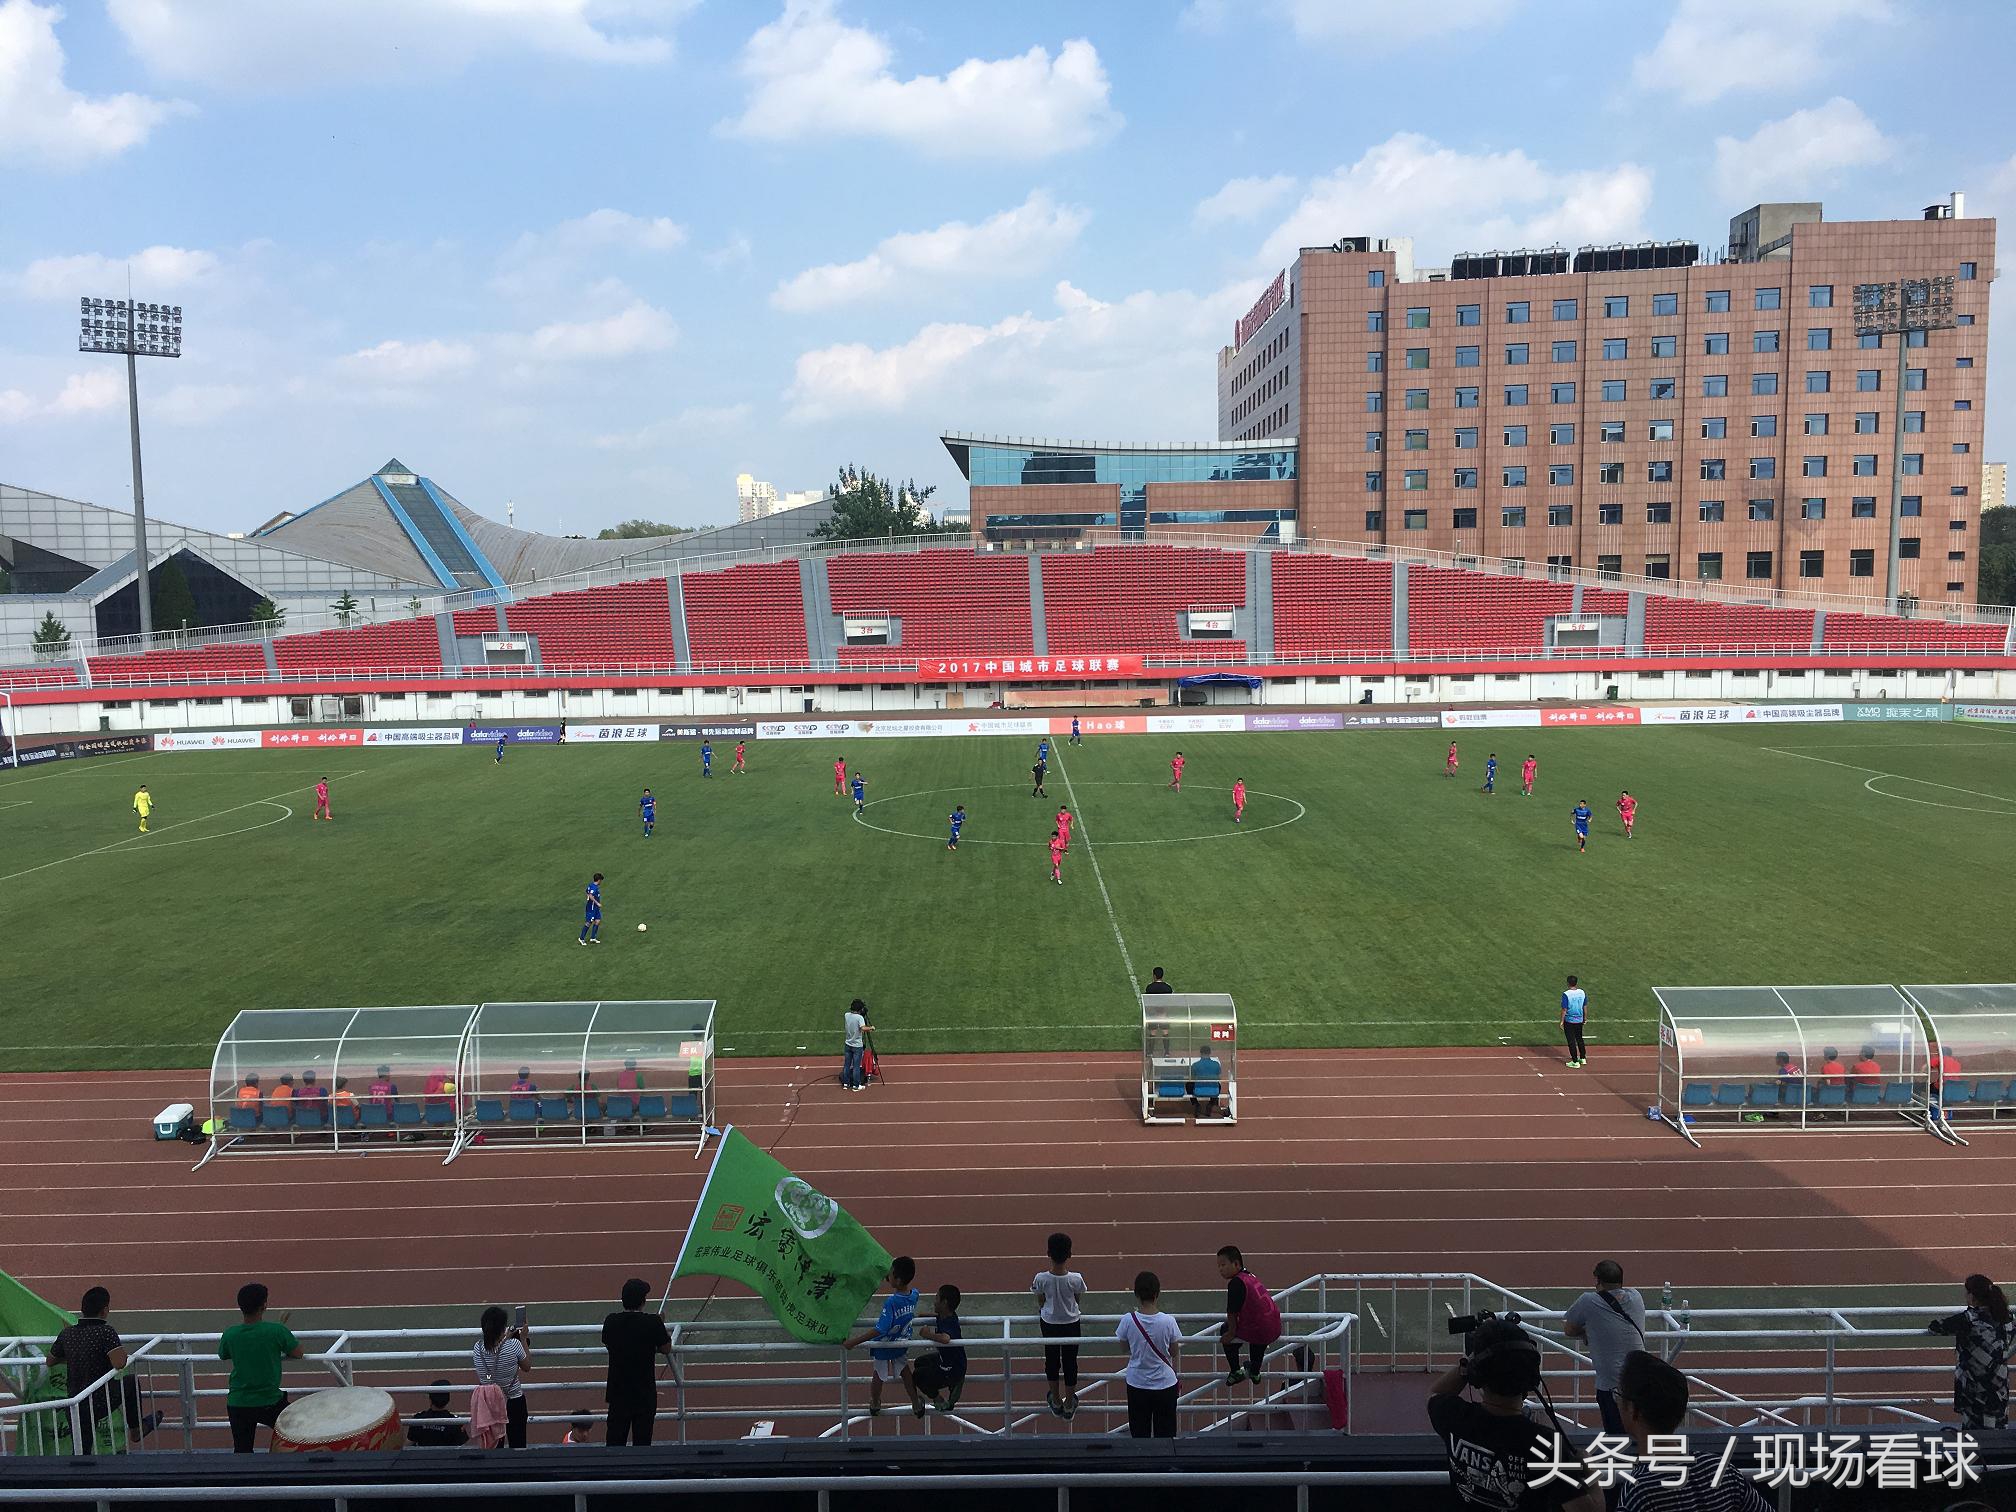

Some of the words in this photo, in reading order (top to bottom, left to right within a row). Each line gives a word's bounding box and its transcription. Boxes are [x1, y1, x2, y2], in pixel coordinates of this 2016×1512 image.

[938, 658, 1120, 673] 2017中国城市足球联赛
[1679, 709, 1730, 720] 茵浪足球
[1763, 708, 1840, 718] 中国高端吸尘器品牌
[384, 732, 460, 741] 中国高端吸尘器品牌
[599, 727, 648, 739] 茵浪足球
[1450, 1432, 1496, 1472] VANS
